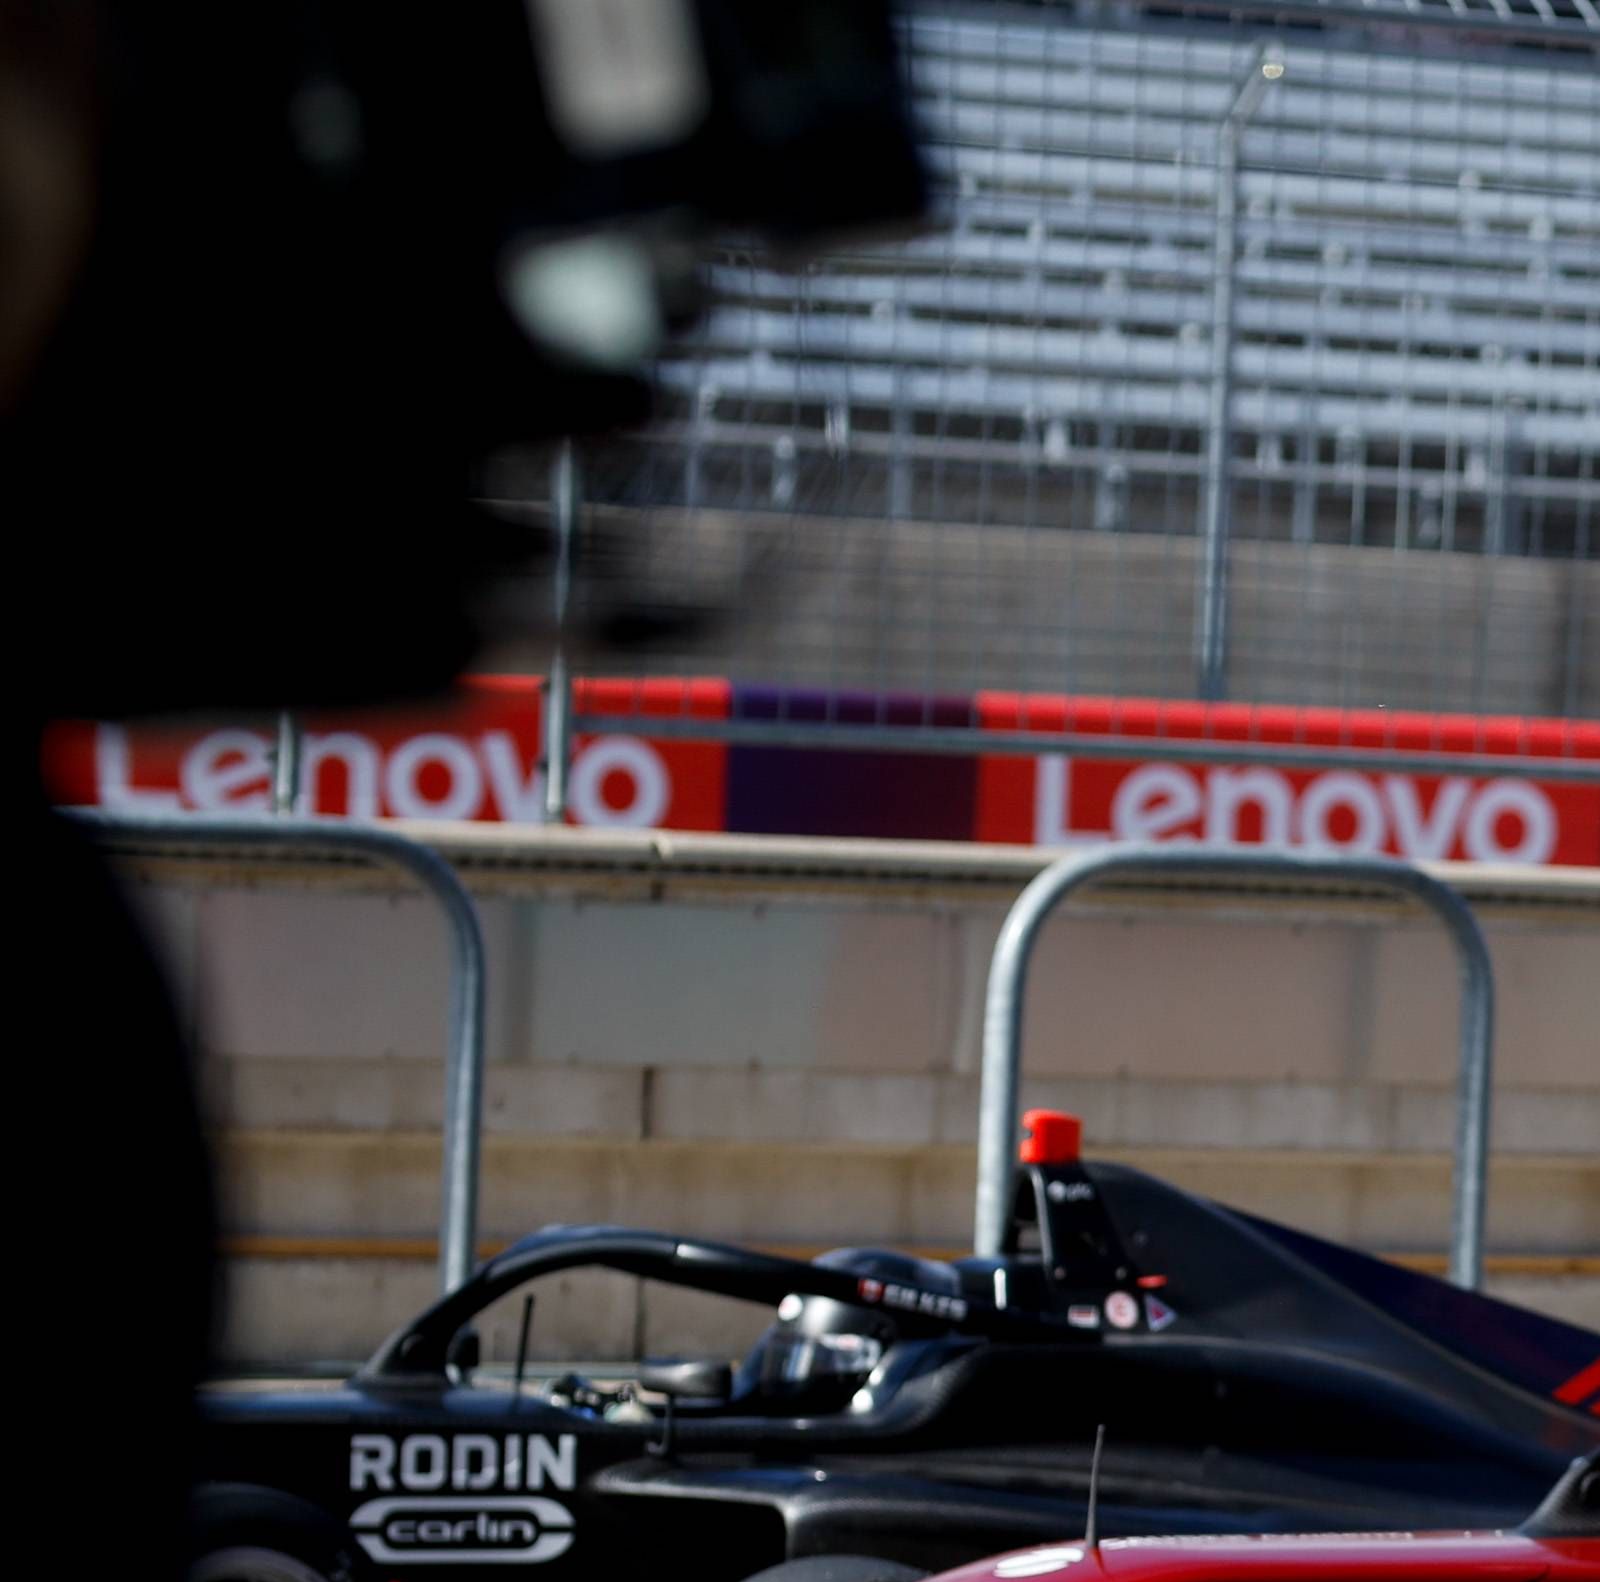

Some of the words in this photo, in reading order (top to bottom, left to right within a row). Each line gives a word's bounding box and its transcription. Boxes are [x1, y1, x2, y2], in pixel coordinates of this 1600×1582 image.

[97, 722, 672, 830] Lenovo
[1034, 752, 1559, 867] Lenovo
[350, 1433, 578, 1491] RODIN
[385, 1511, 537, 1543] carlin
